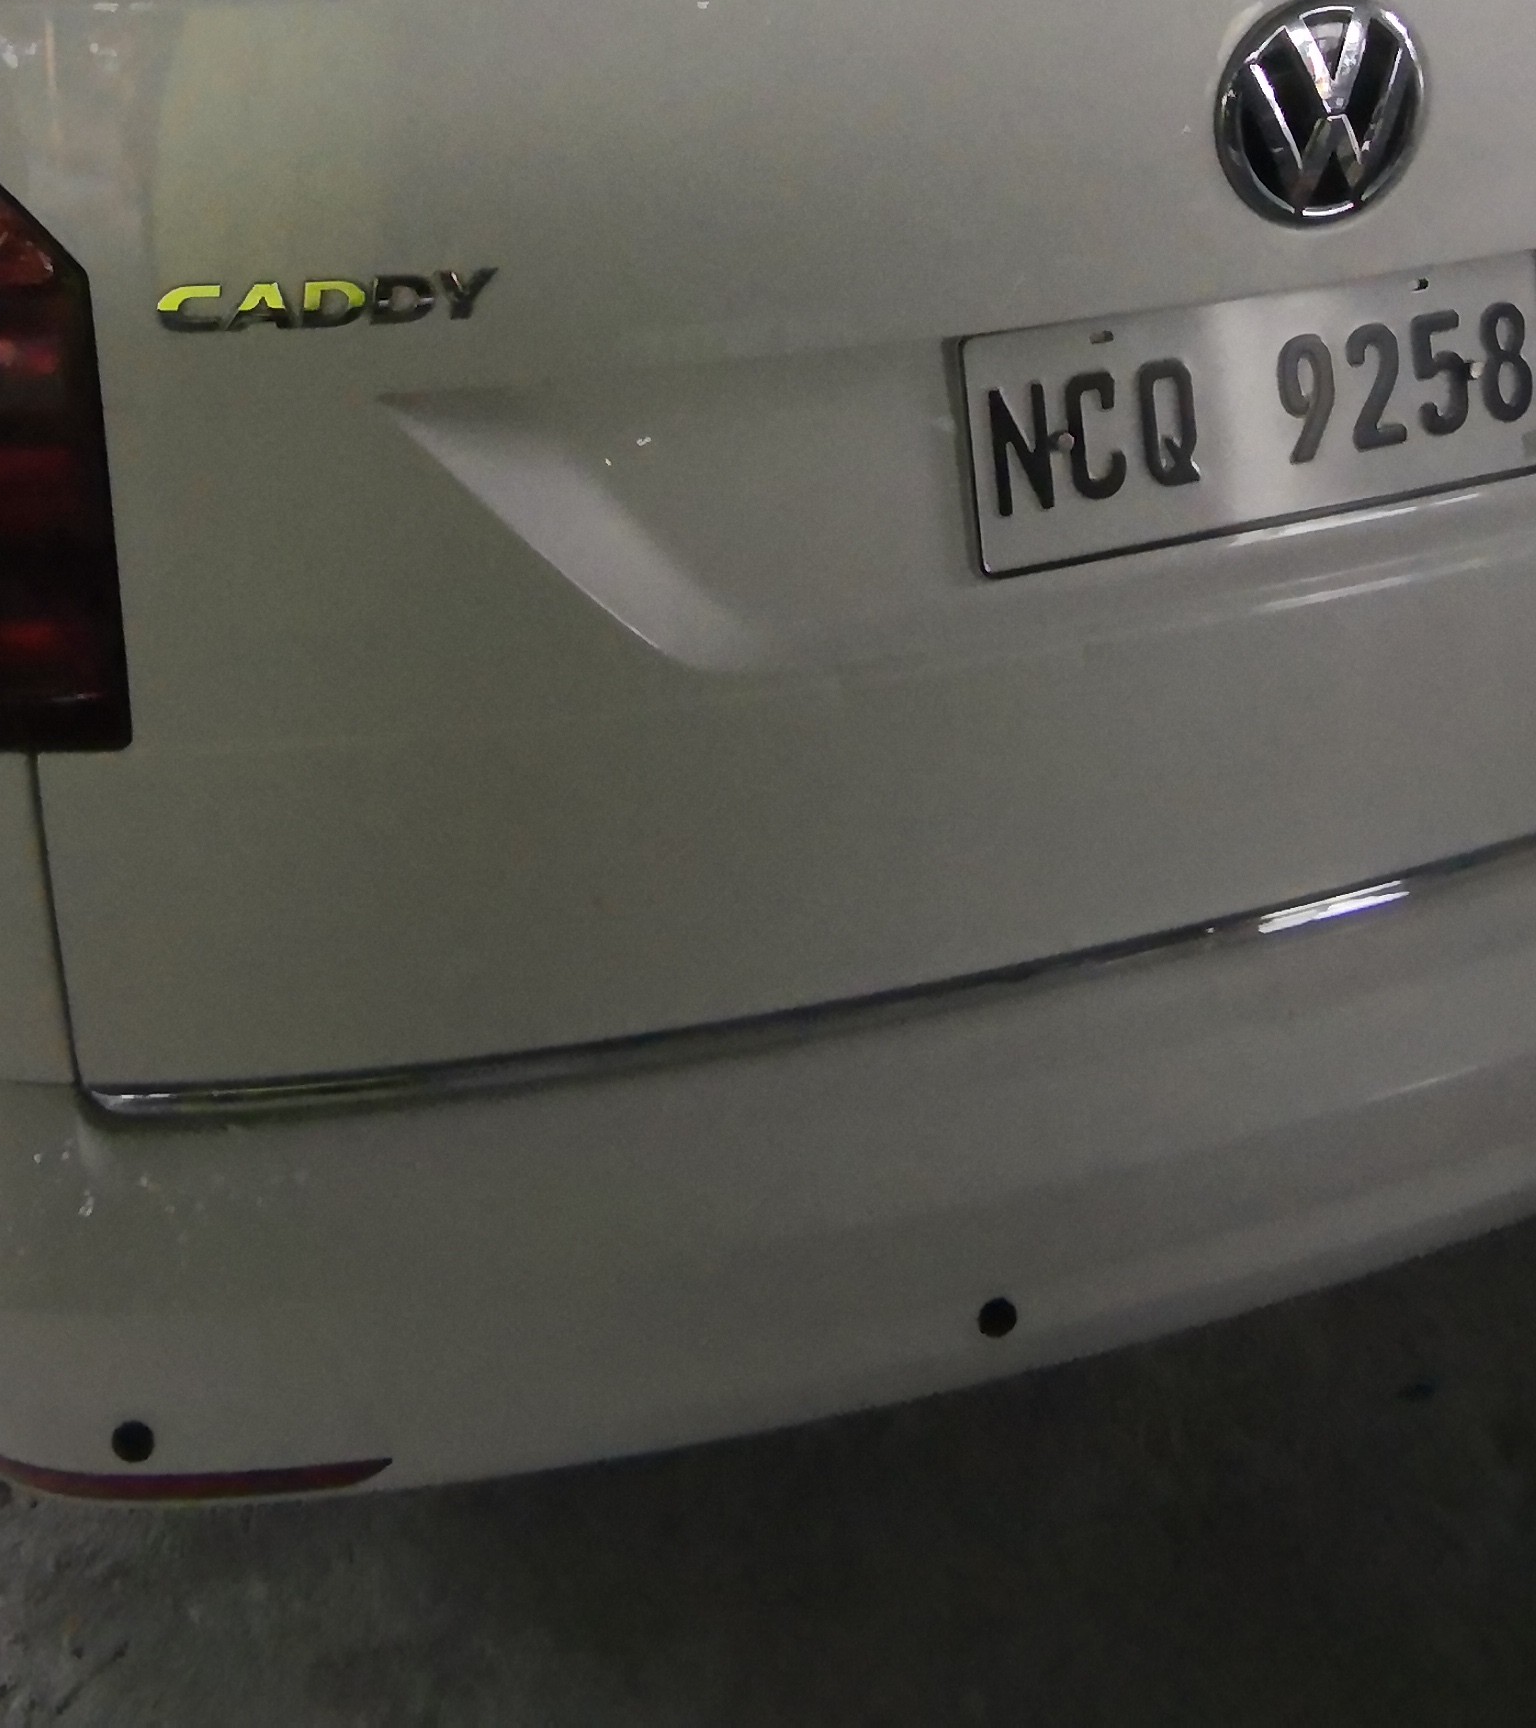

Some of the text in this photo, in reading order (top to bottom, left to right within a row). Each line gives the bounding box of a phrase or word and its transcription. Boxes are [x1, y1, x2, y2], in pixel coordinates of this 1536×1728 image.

[156, 266, 499, 333] CADDY
[987, 301, 1534, 517] NCQ 9258
